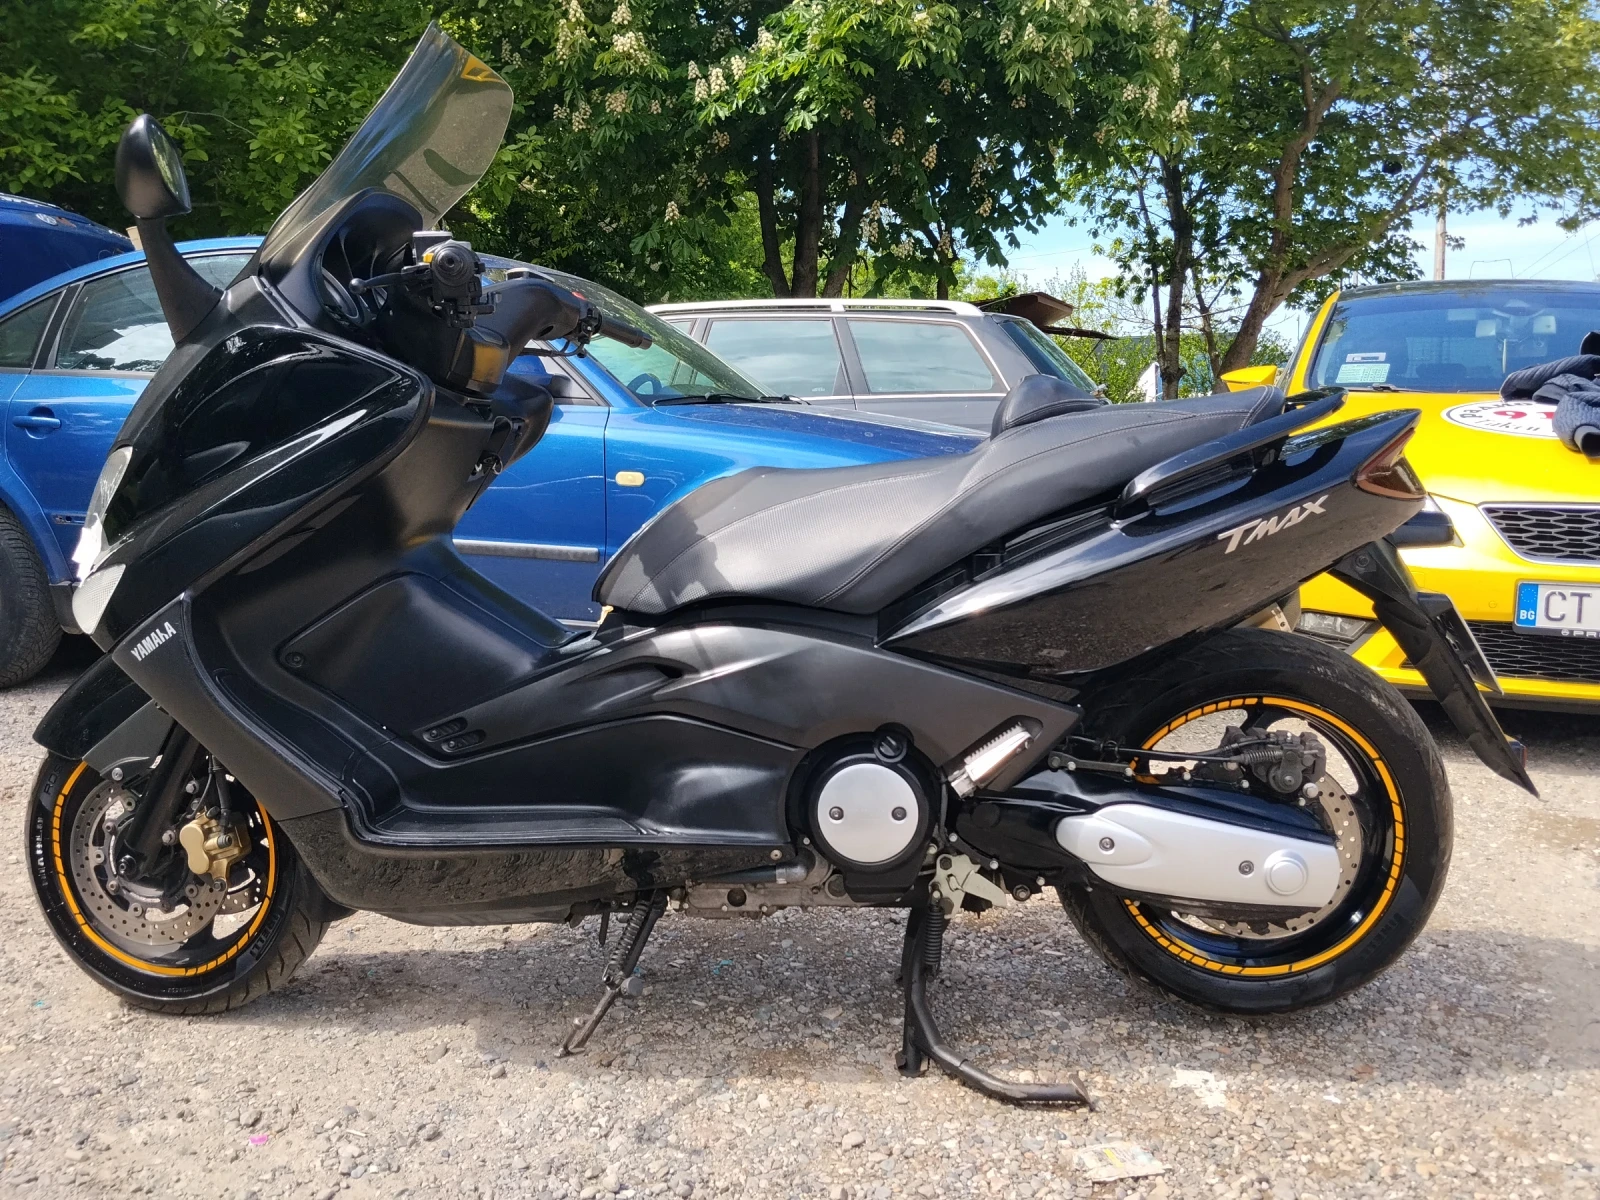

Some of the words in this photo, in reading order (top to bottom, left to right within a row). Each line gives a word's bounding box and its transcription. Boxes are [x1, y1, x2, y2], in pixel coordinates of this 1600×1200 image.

[1217, 494, 1329, 554] TMAX
[1519, 609, 1535, 620] BG
[1544, 590, 1592, 624] CT
[1573, 630, 1600, 638] PR
